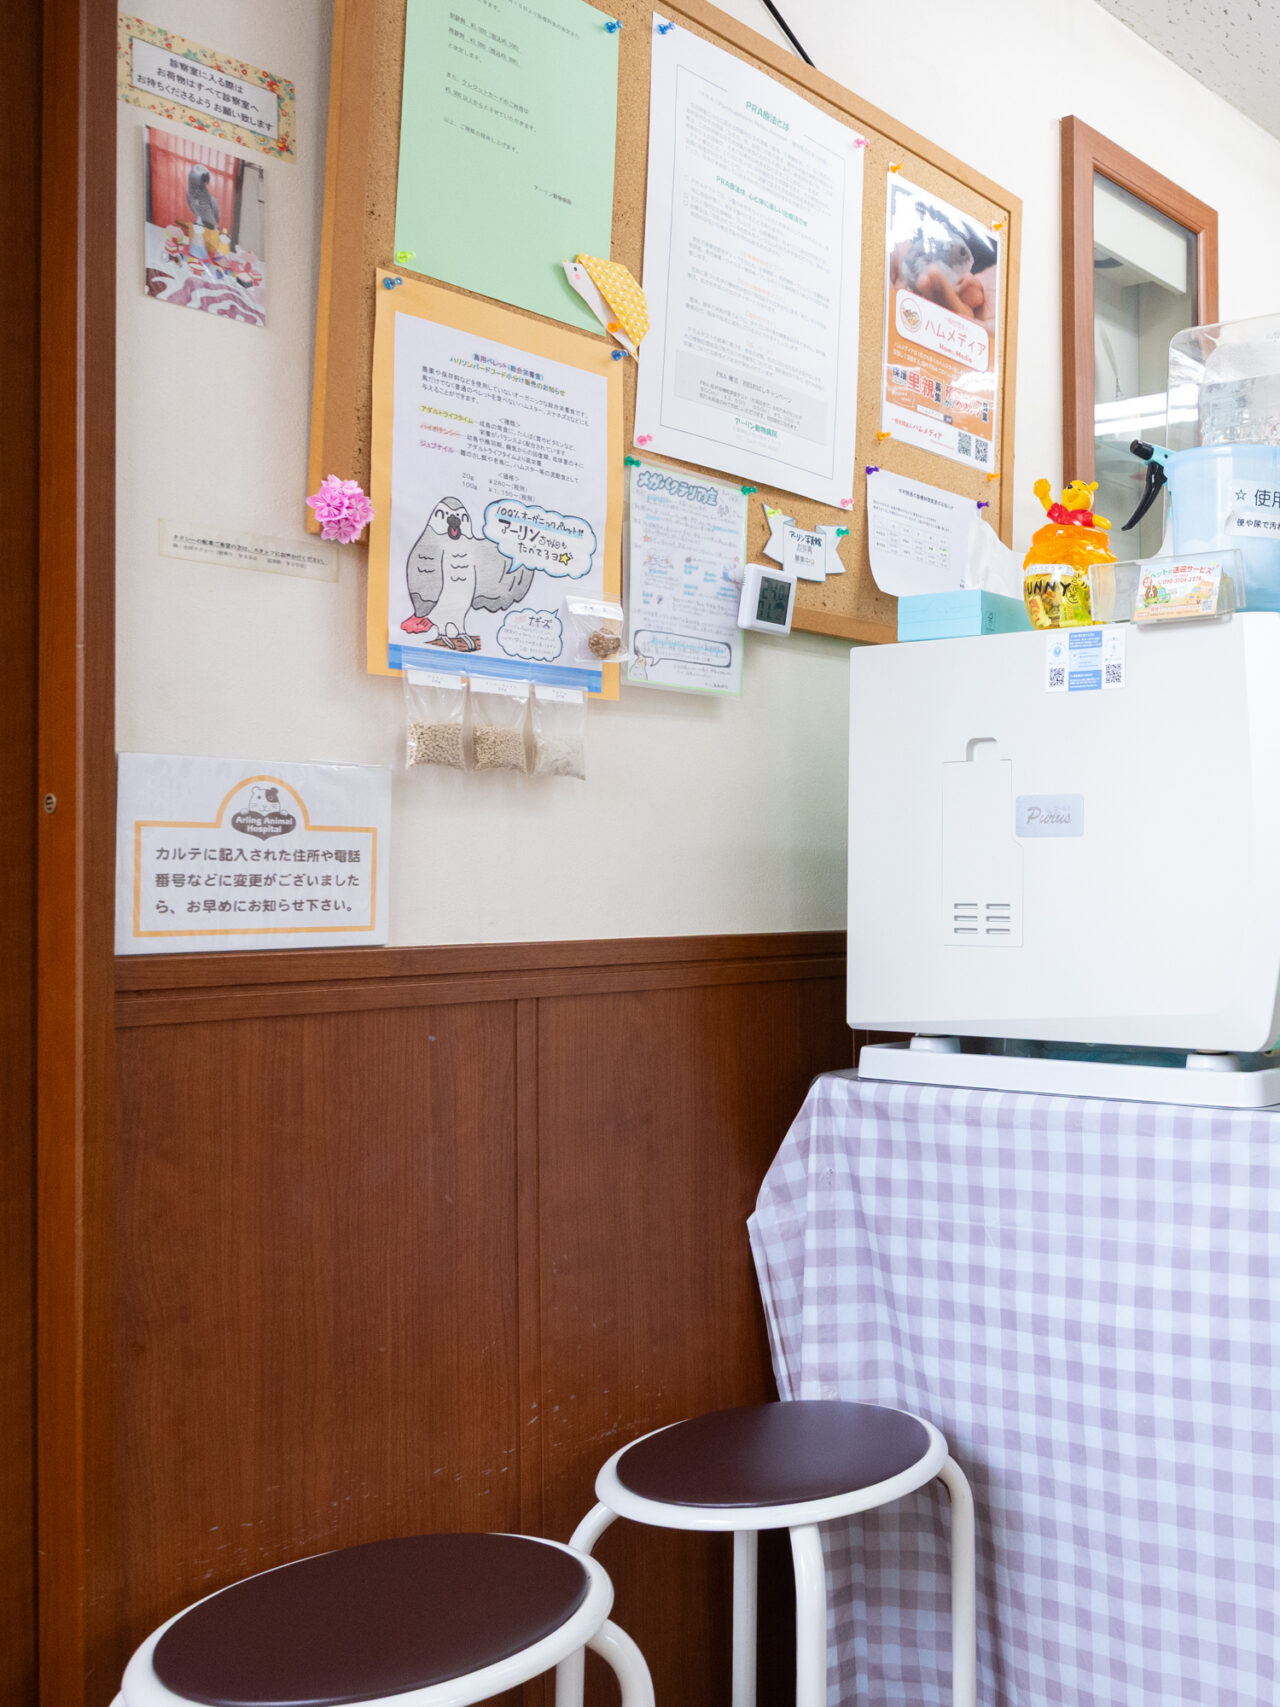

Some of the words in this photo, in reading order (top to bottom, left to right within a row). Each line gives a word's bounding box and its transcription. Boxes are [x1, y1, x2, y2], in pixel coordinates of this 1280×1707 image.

[169, 58, 244, 94] 診察室に入る際は
[157, 67, 260, 113] お荷物はすべて診察室へ
[136, 74, 212, 110] お持ちくださるよう
[213, 103, 274, 132] お願い致します
[924, 318, 987, 357] ハムメディア
[1025, 580, 1072, 597] UNNY
[235, 815, 261, 828] Arling
[262, 815, 294, 828] Animal
[246, 823, 283, 836] Hospital
[155, 846, 361, 864] カルテに記入された住所や電話
[155, 872, 360, 889] 番号などに変更がございました
[155, 897, 354, 915] ら、お早めにお知らせ下さい。
